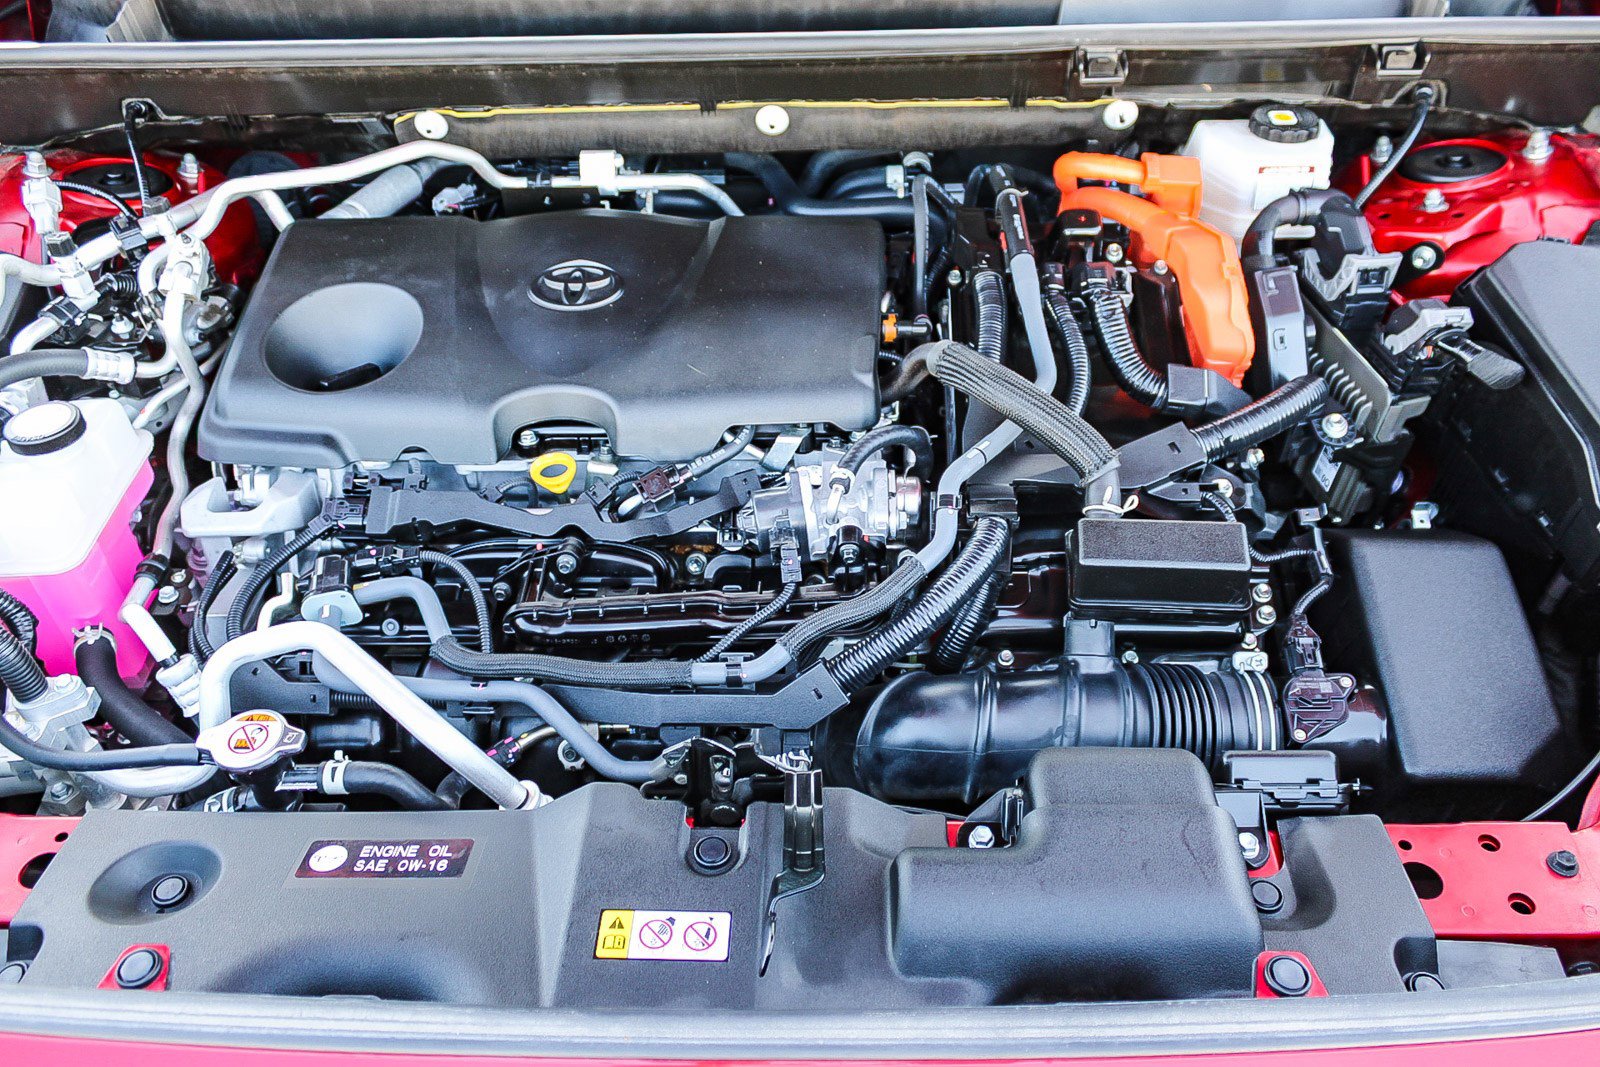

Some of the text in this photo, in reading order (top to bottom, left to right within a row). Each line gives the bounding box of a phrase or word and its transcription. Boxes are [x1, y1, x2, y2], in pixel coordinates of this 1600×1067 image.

[359, 845, 453, 858] ENGINE OIL
[353, 859, 389, 872] SAE
[397, 859, 449, 872] 0W-16
